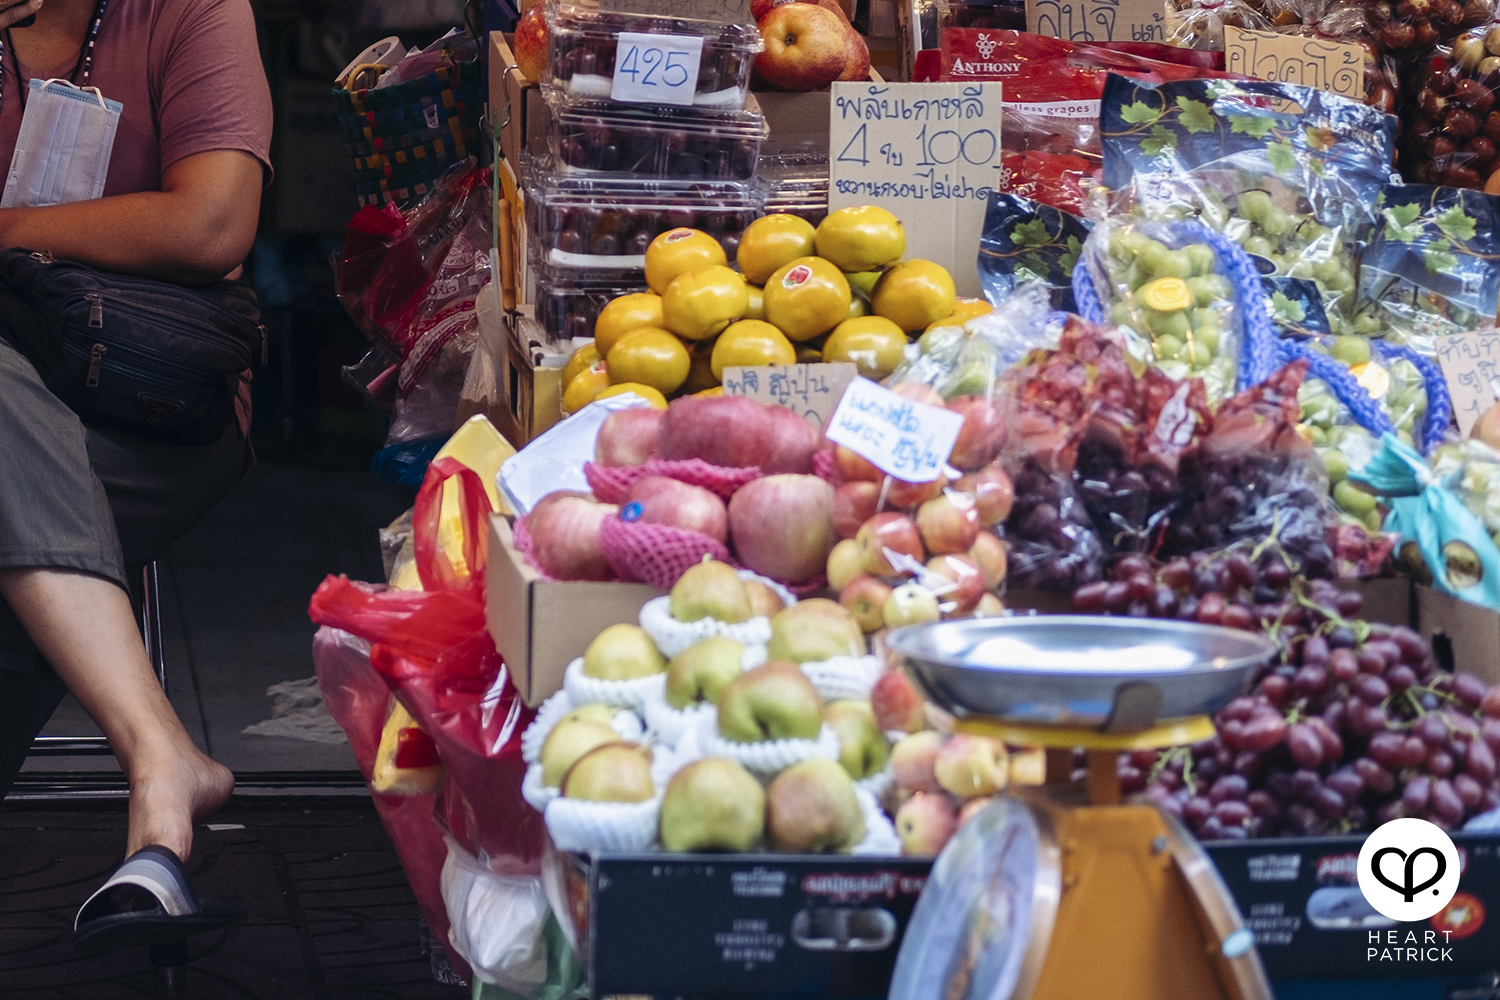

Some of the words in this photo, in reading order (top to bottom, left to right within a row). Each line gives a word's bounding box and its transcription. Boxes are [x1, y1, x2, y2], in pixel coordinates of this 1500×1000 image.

[1131, 12, 1165, 41] แท้
[619, 44, 690, 87] 425
[951, 57, 1021, 76] ANTHONY
[836, 84, 985, 121] พลับเกาหลี
[1046, 103, 1090, 120] grapes
[836, 123, 870, 167] 4
